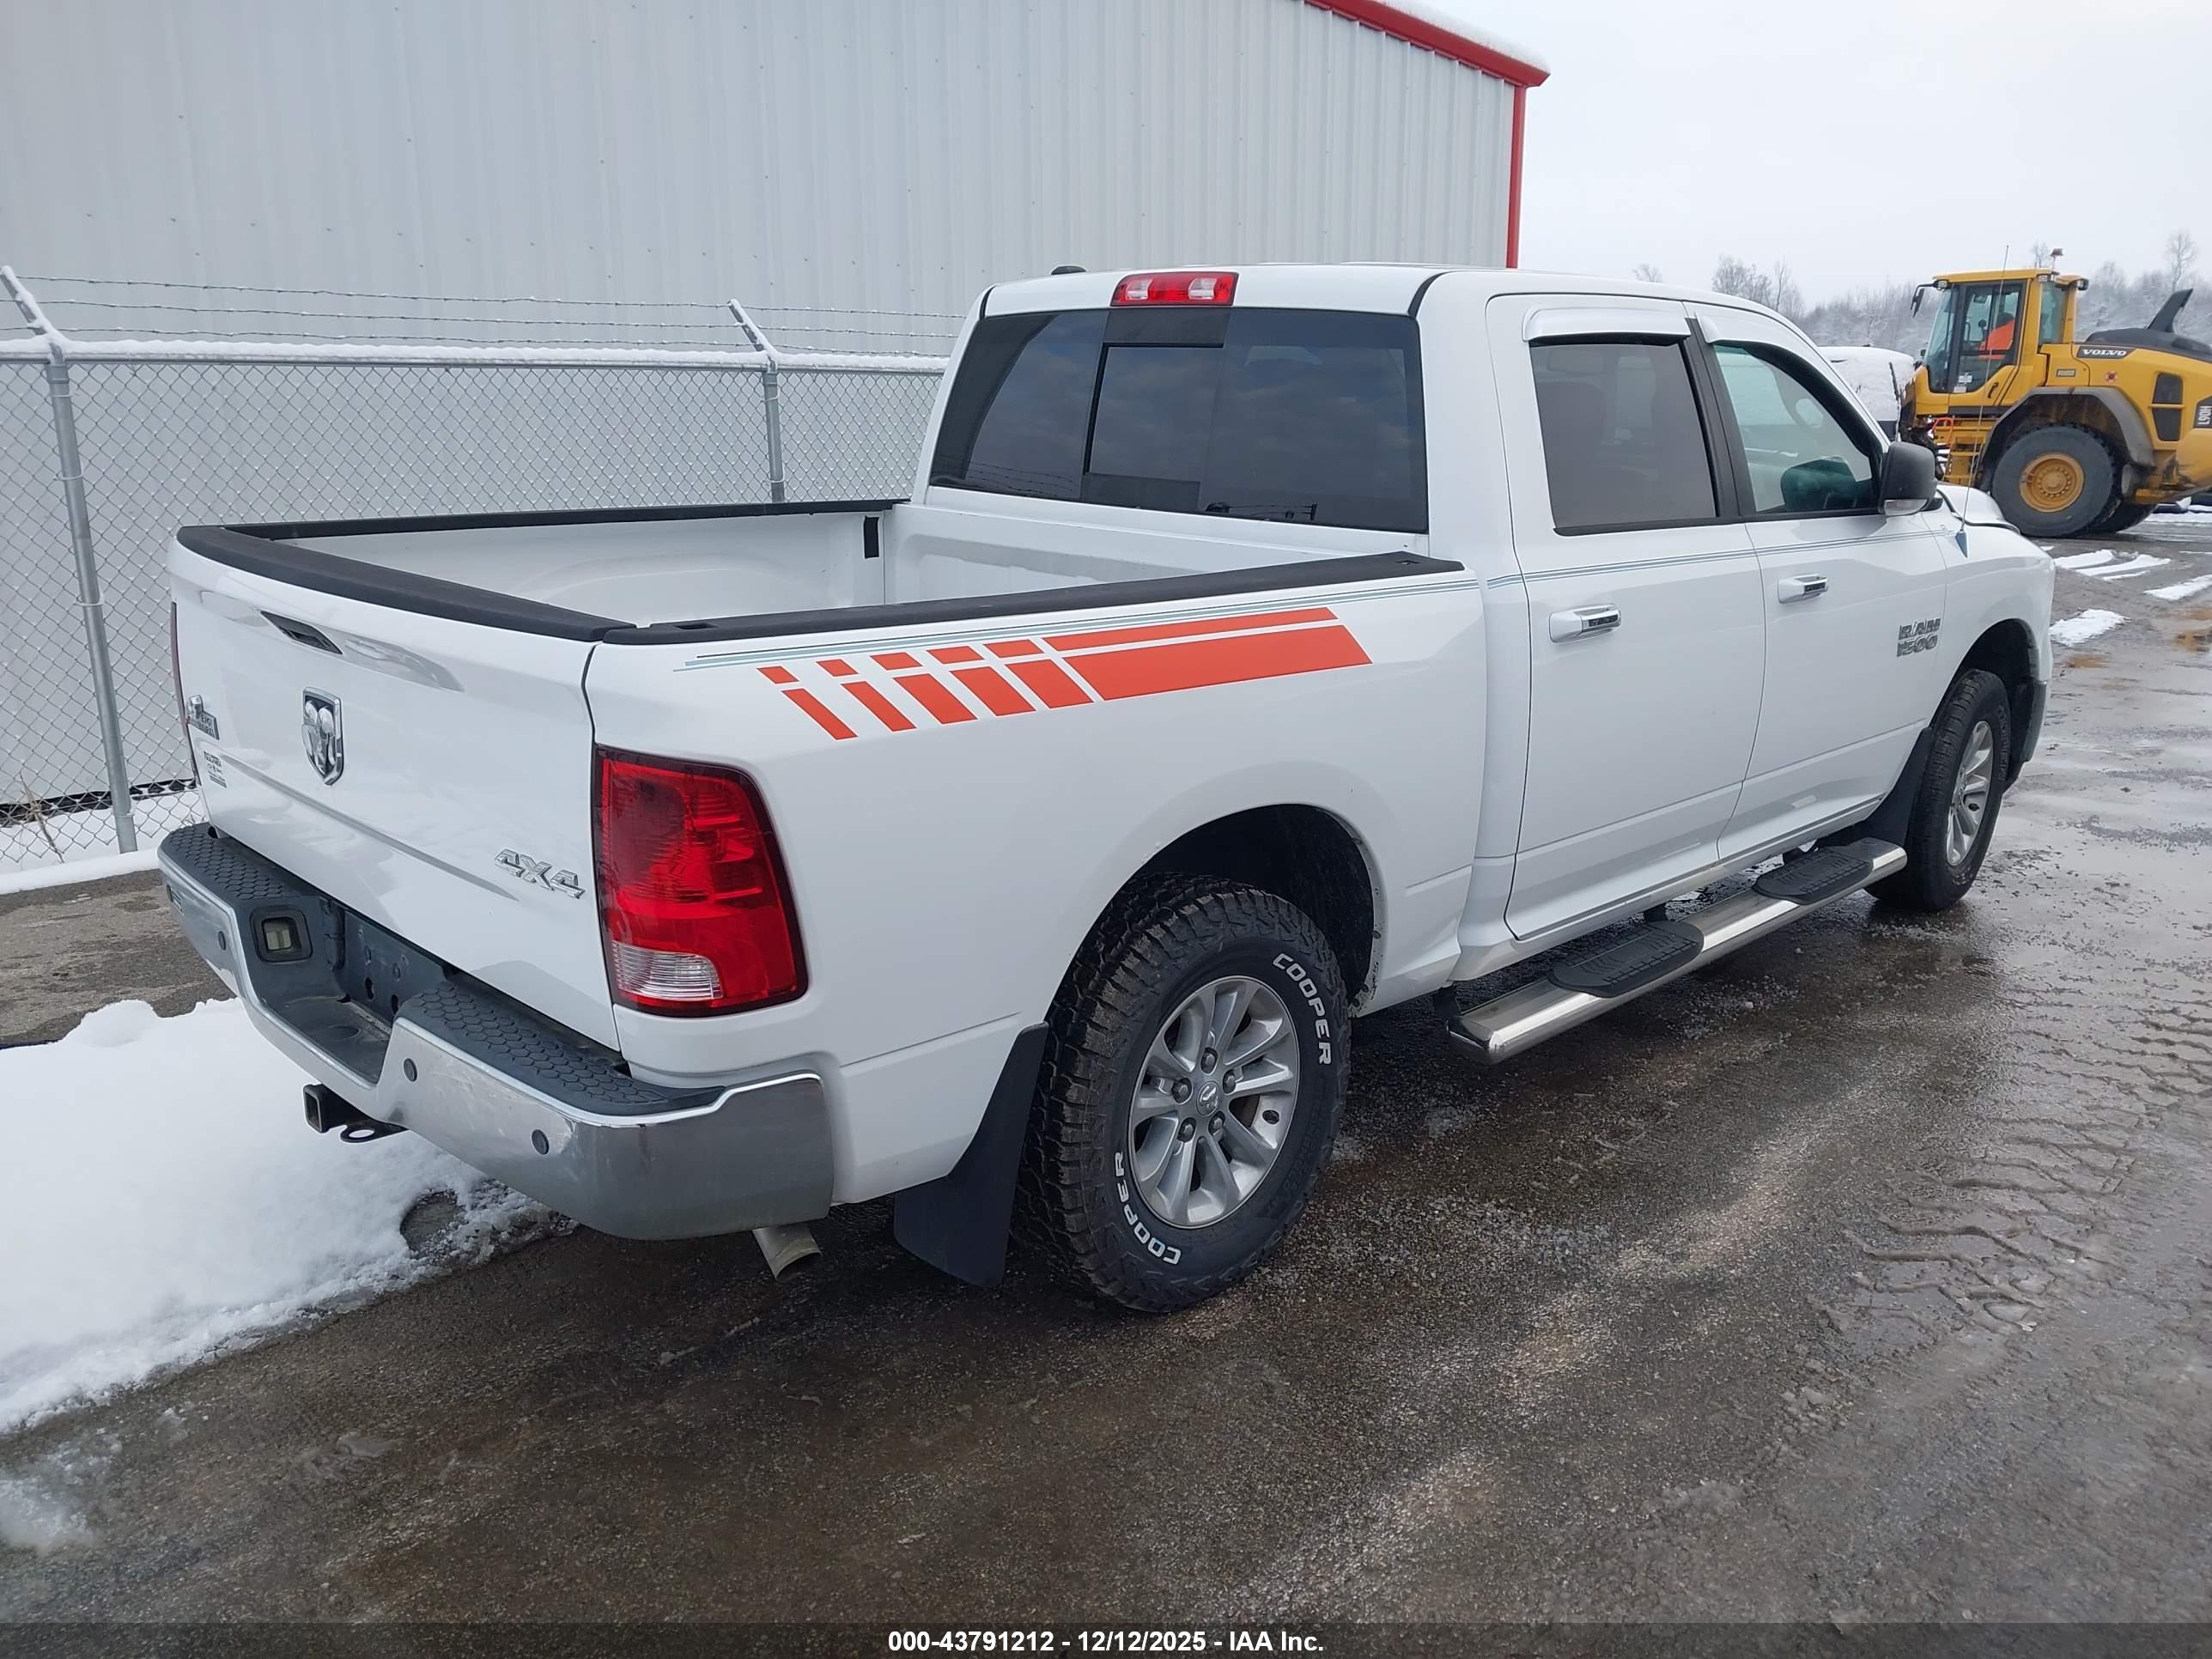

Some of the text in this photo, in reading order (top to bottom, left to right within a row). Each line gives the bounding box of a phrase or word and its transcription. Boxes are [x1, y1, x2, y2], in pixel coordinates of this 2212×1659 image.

[1899, 617, 1941, 641] RAM
[1273, 953, 1331, 1065] COOPER
[1115, 1152, 1182, 1265] COOPER
